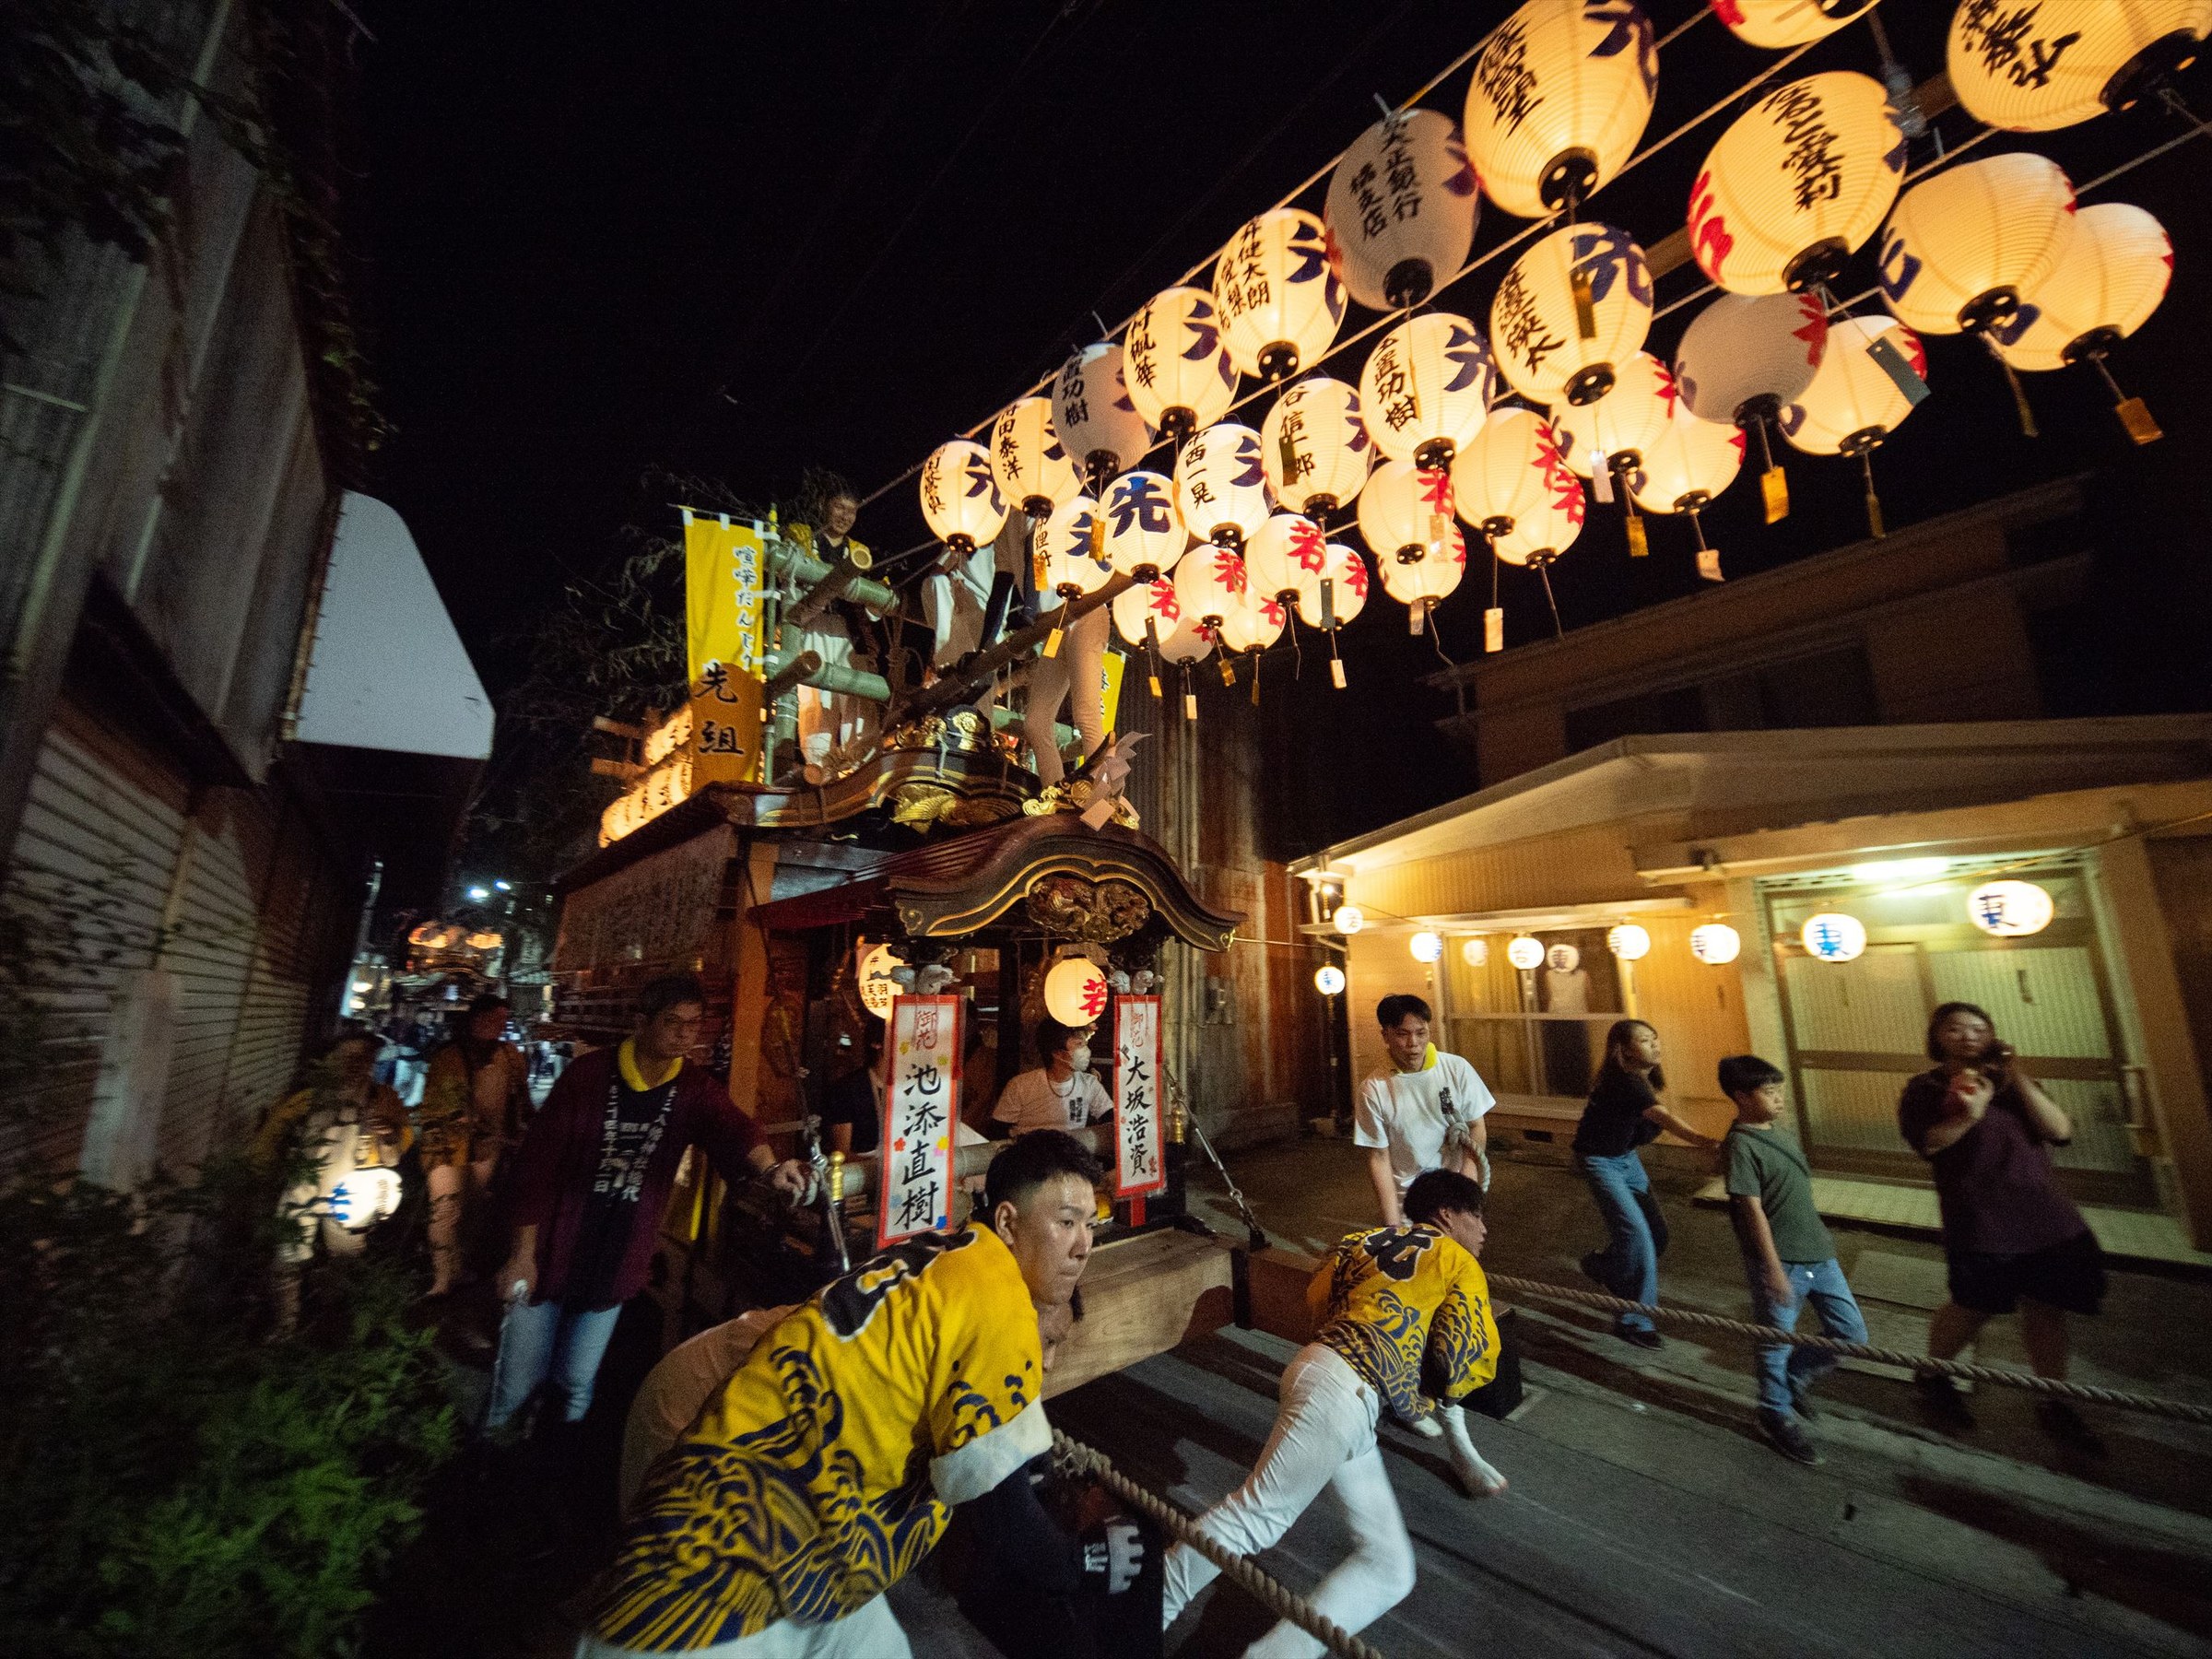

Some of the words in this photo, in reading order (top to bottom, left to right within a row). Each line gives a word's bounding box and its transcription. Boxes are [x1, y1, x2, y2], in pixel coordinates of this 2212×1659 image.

[1570, 224, 1653, 309] 先
[1442, 322, 1500, 415] 先
[1109, 477, 1172, 538] 先
[1287, 520, 1327, 575] 若
[1149, 576, 1181, 624] 若
[695, 664, 744, 755] 先組
[1811, 921, 1851, 957] 東
[1078, 973, 1107, 1018] 若
[893, 1063, 947, 1231] 池添直樹
[1124, 1055, 1152, 1178] 大坂浩資
